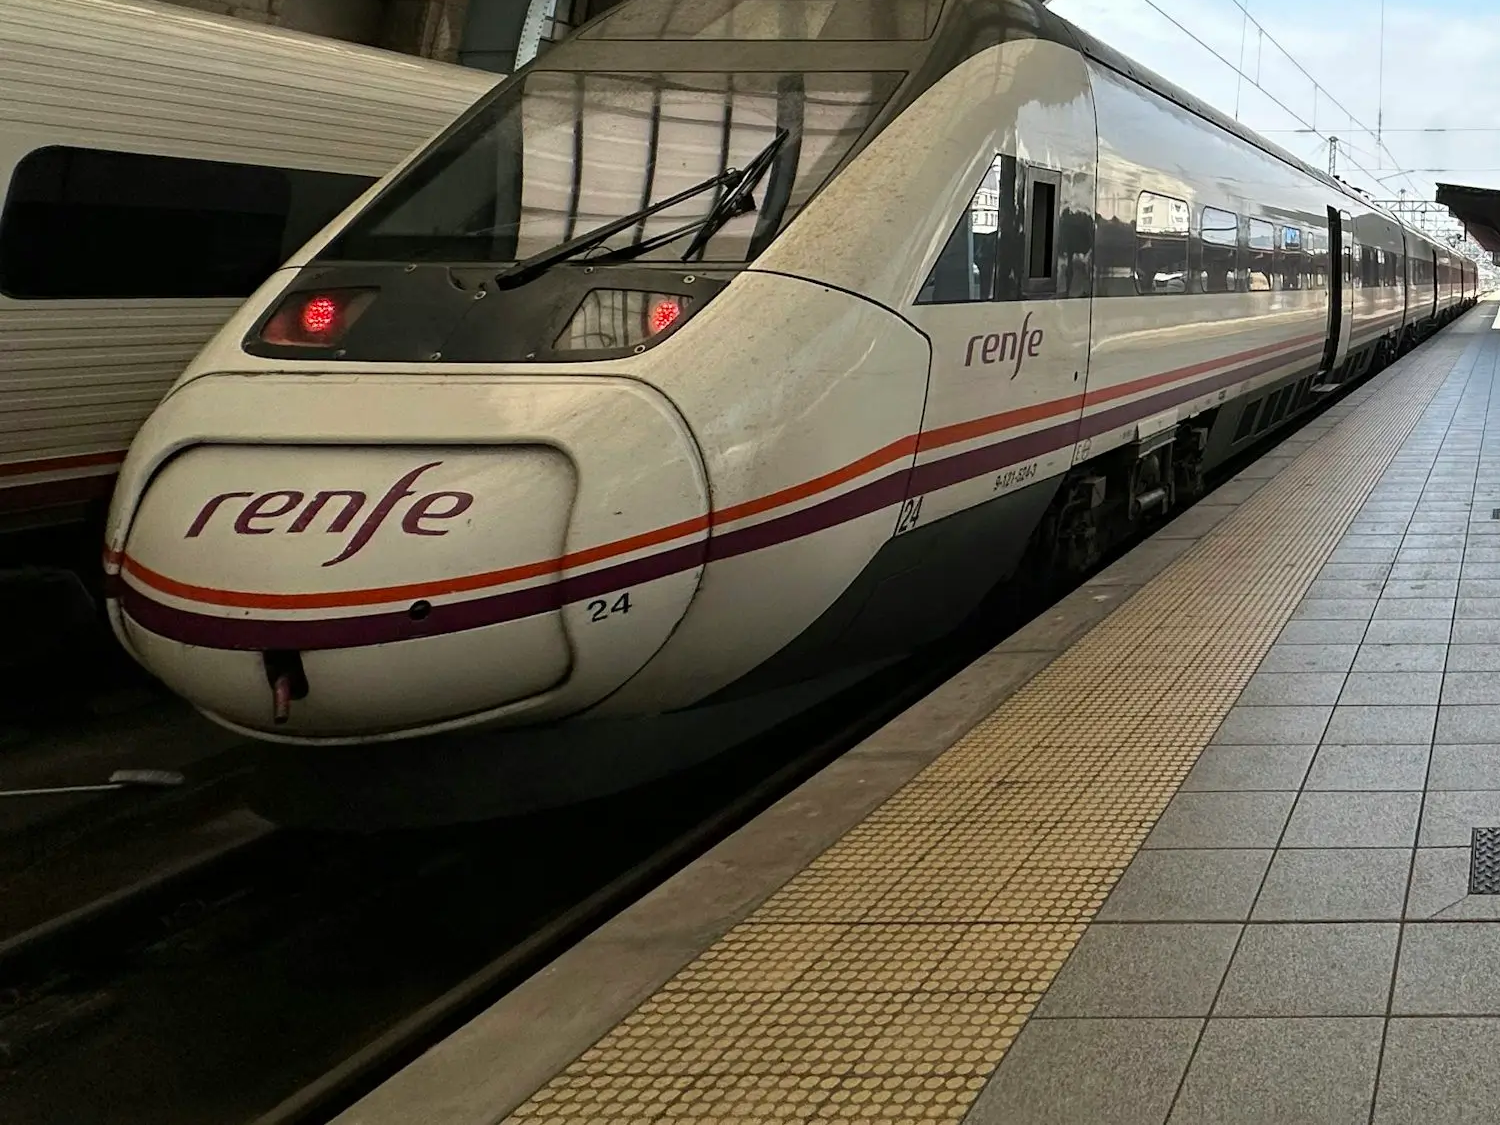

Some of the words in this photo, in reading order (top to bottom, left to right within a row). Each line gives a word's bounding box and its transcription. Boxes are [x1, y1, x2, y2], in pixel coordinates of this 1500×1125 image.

[964, 311, 1044, 381] renfe
[184, 461, 474, 567] renfe
[898, 495, 924, 533] 24
[587, 592, 632, 622] 24
